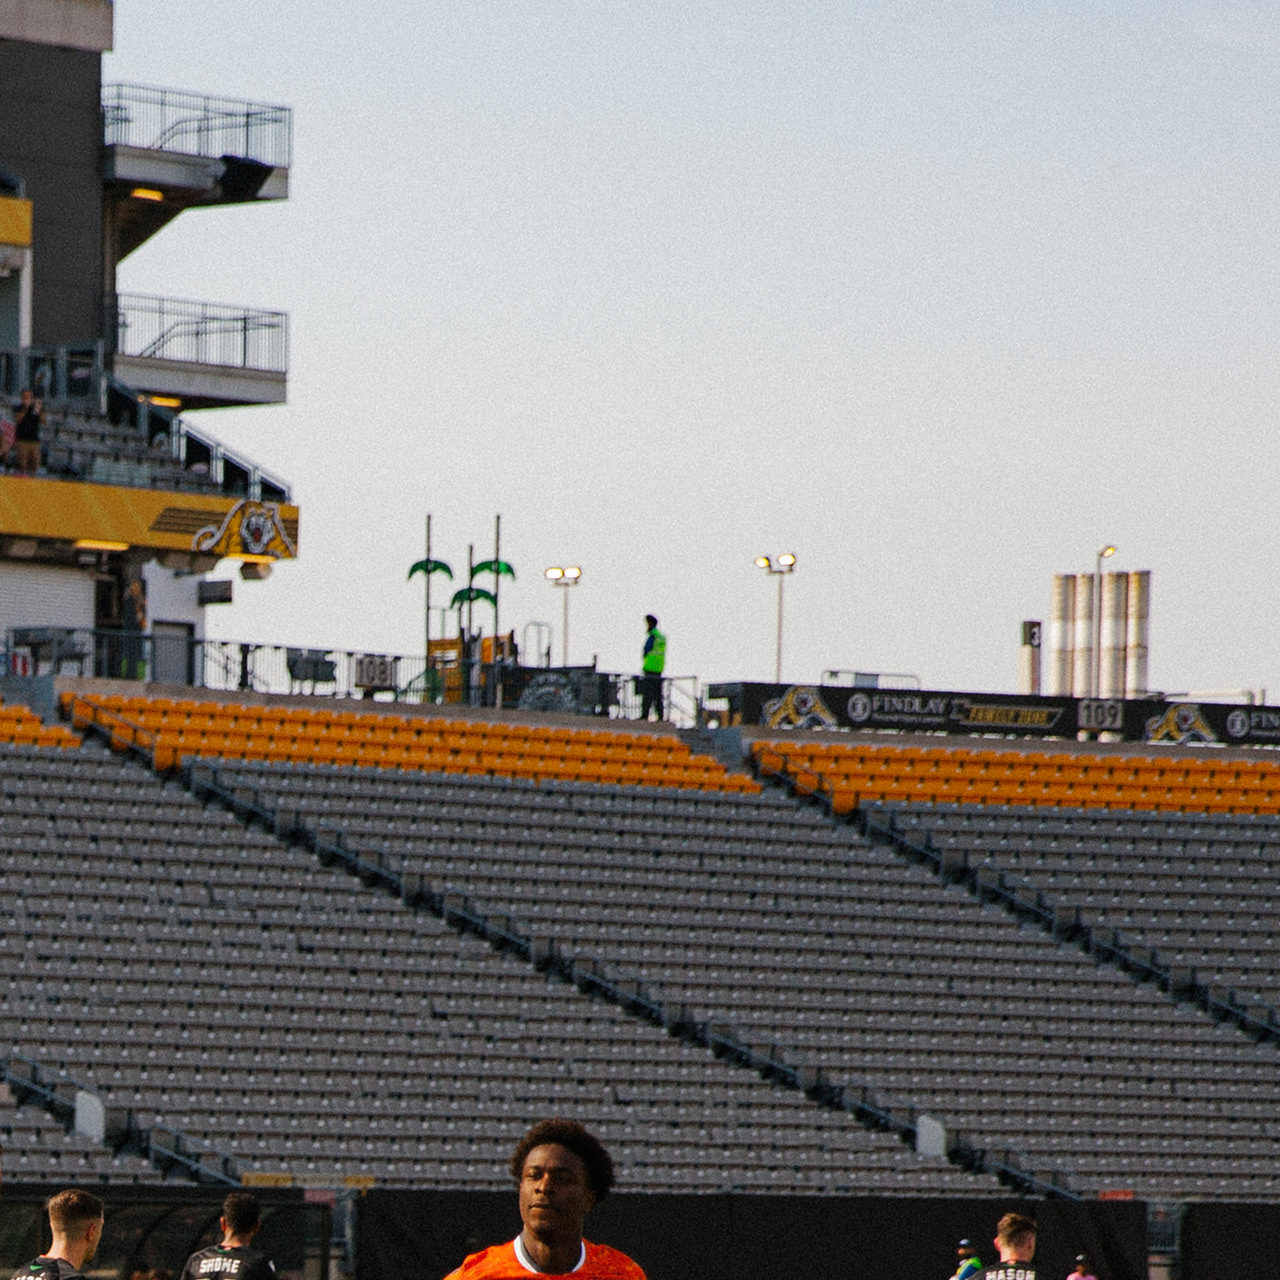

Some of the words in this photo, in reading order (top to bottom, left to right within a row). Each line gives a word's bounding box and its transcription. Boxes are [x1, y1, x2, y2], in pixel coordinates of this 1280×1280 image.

[873, 695, 948, 715] FINDLAY
[1082, 702, 1121, 726] 109
[199, 1257, 242, 1274] SHOME
